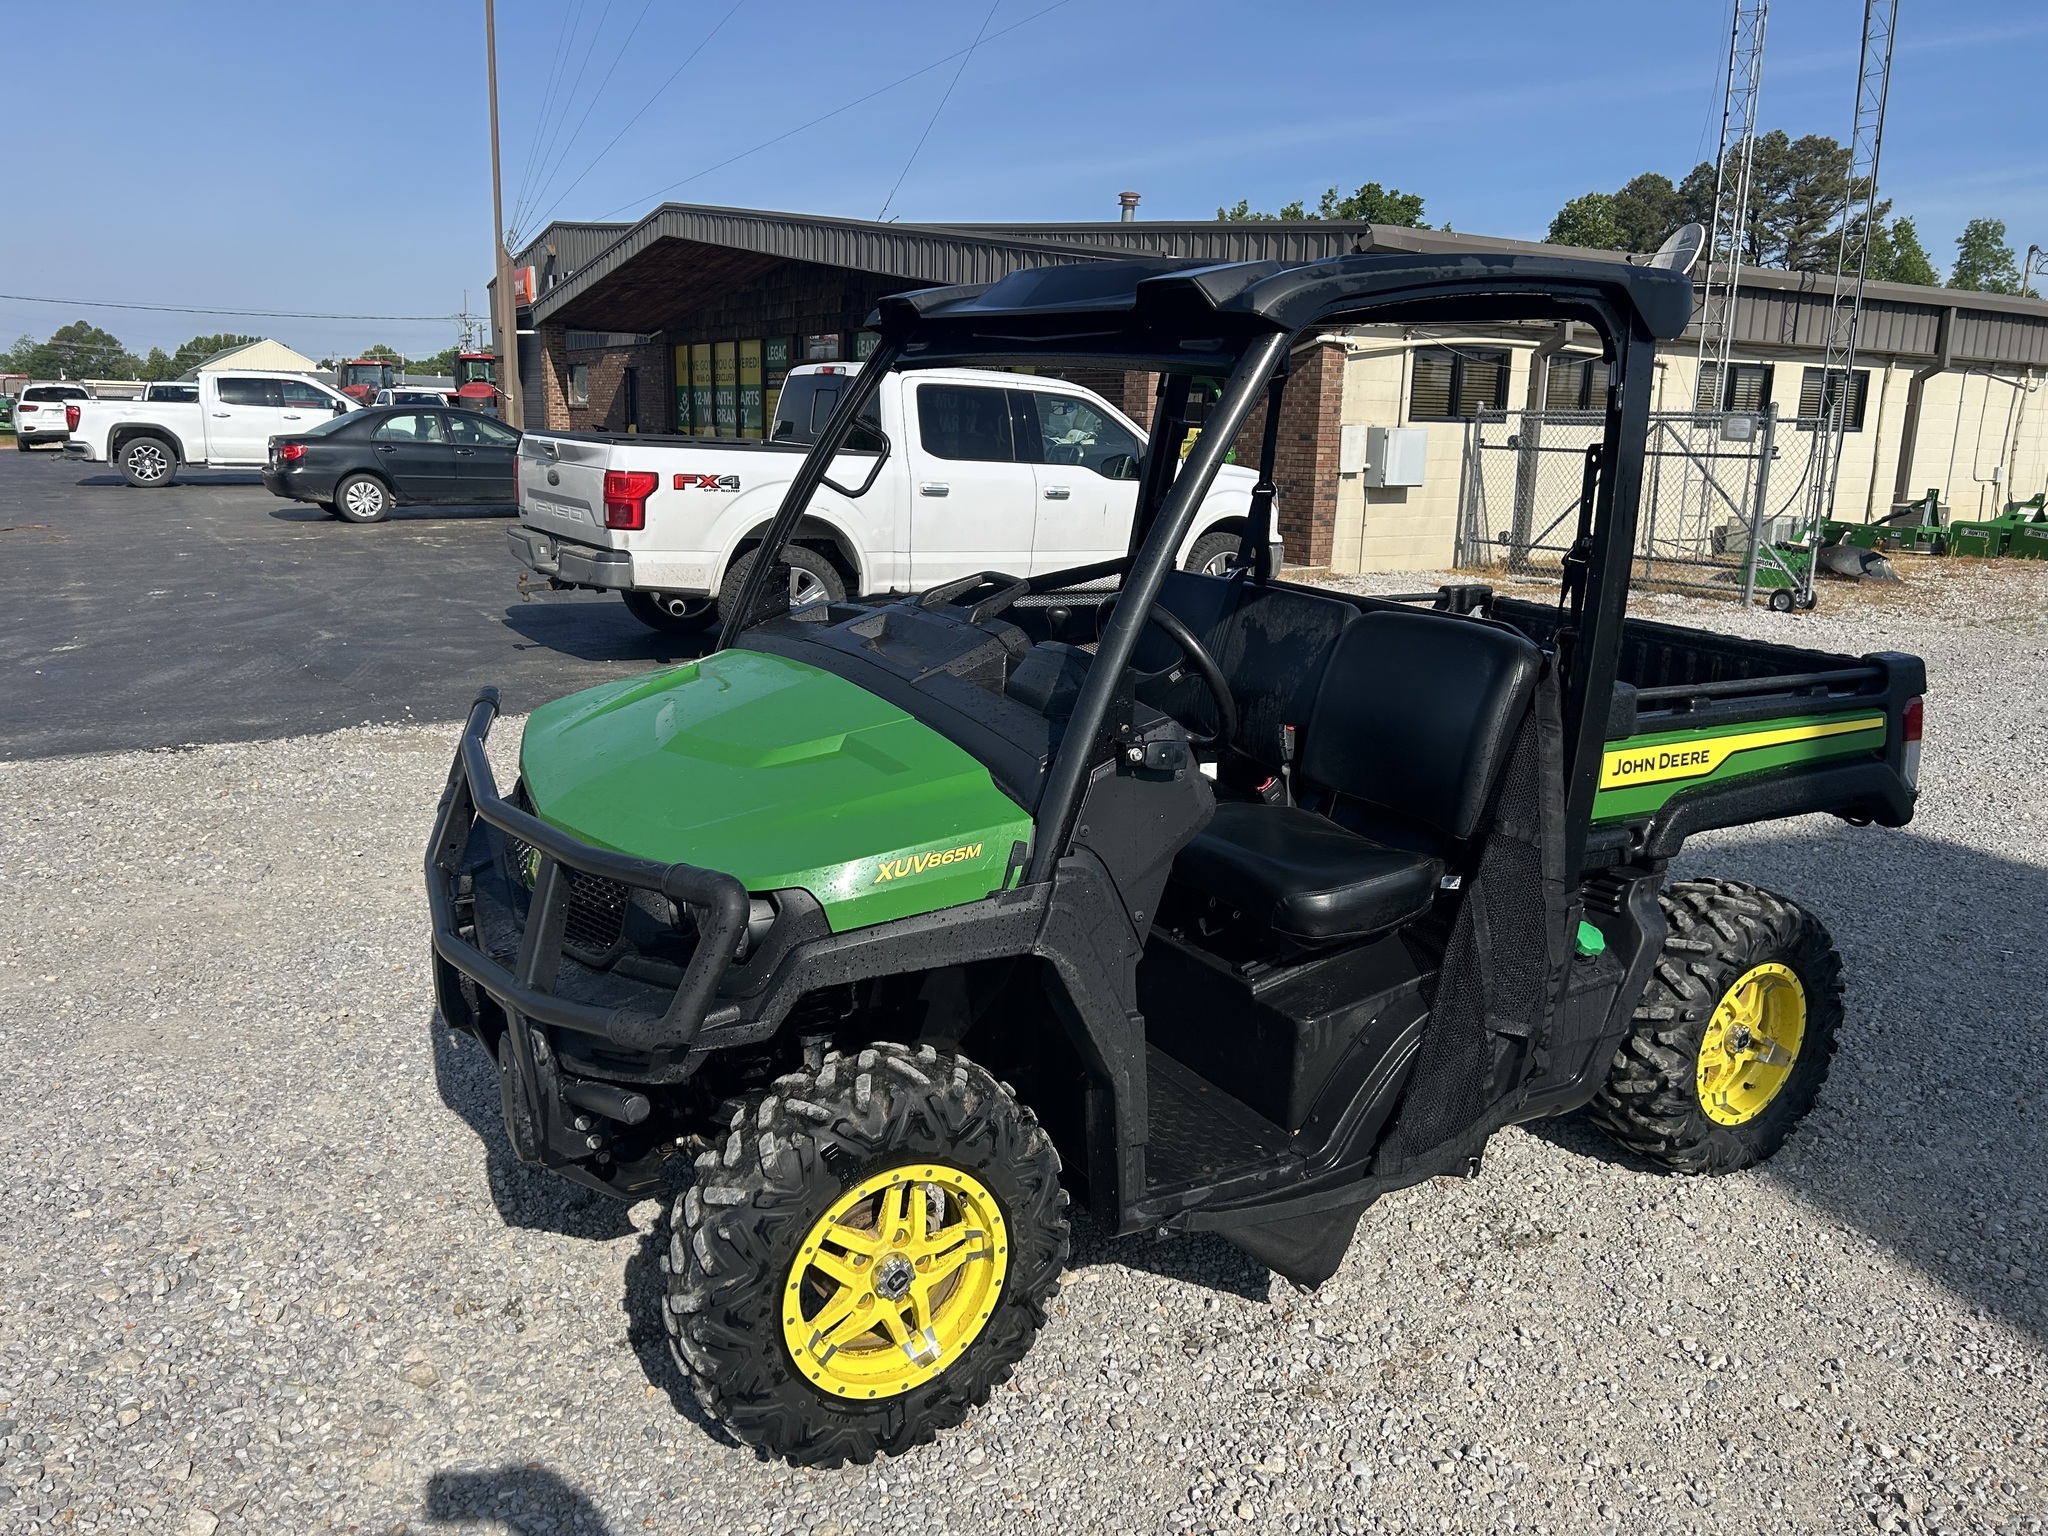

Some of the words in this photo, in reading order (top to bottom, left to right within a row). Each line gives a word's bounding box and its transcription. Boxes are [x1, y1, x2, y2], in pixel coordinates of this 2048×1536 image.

[767, 345, 787, 361] LEGAC
[857, 339, 880, 357] LEAD
[728, 356, 760, 369] COERED!
[693, 391, 733, 406] 12-MNTH
[740, 390, 760, 406] ARTS
[703, 408, 749, 423] WRRANTY
[673, 474, 741, 490] FX4
[1611, 757, 1656, 776] JOHN
[1658, 749, 1710, 770] DEERE
[872, 843, 983, 884] XUV865M
